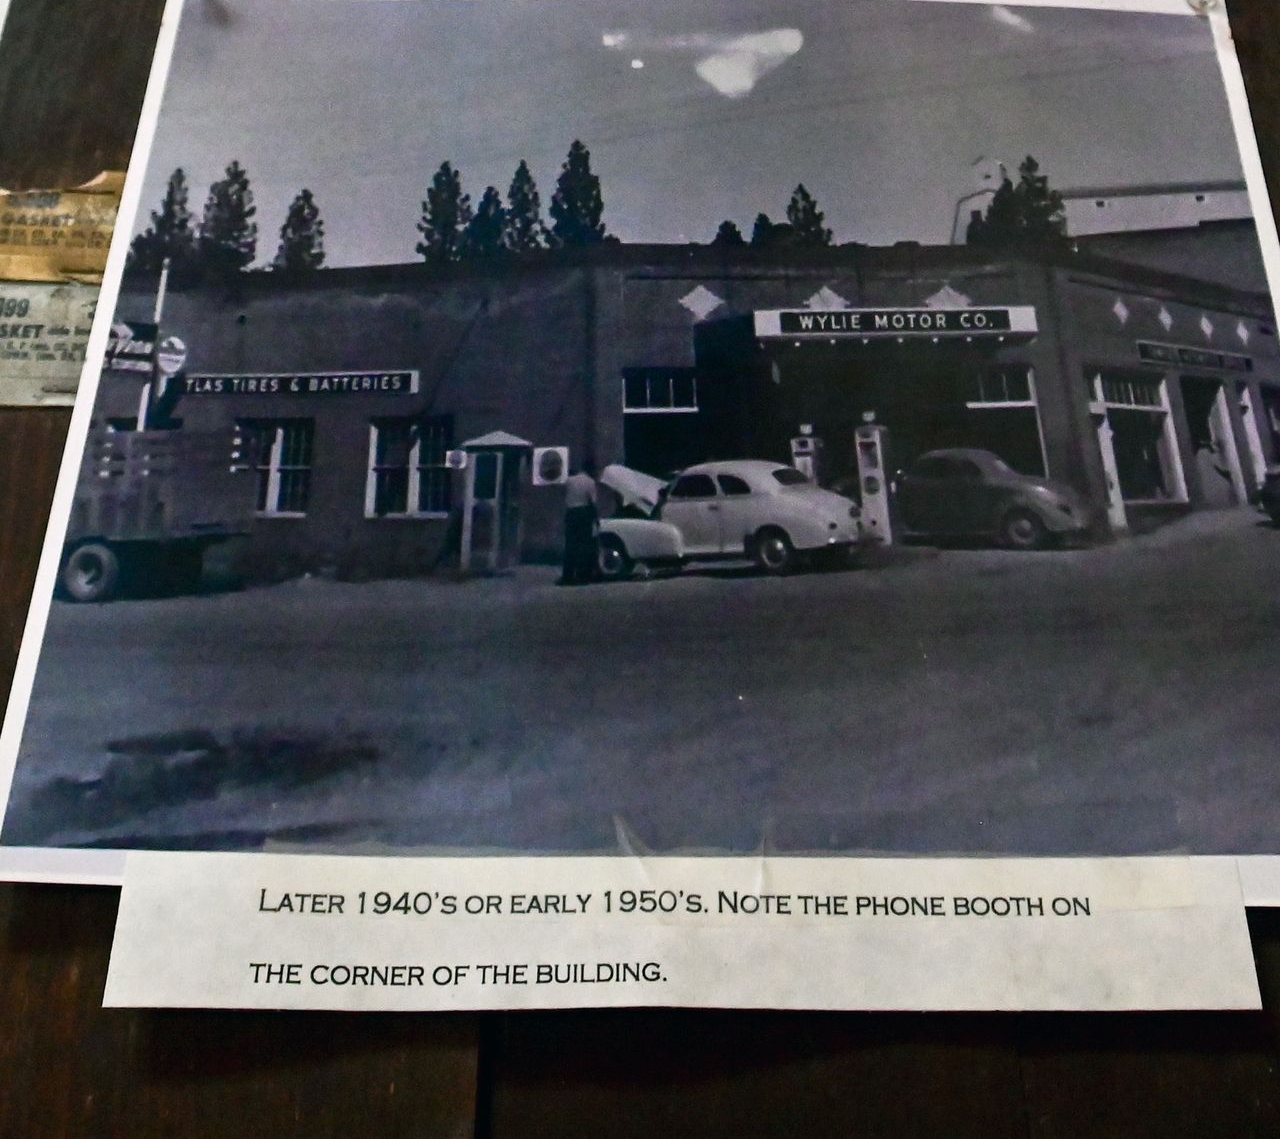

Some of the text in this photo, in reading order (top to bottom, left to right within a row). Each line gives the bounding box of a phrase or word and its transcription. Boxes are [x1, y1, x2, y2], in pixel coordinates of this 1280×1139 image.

[799, 313, 994, 329] WYLIE MOTOR CO.
[185, 374, 401, 393] TLAS TIRES & BATTERIES
[258, 888, 1091, 917] LATER 1940'S OR EARLY 1950'S. NOTE THE PHONE BOOTH ON
[249, 962, 668, 987] THE CORNER OF THE BUILDING.
